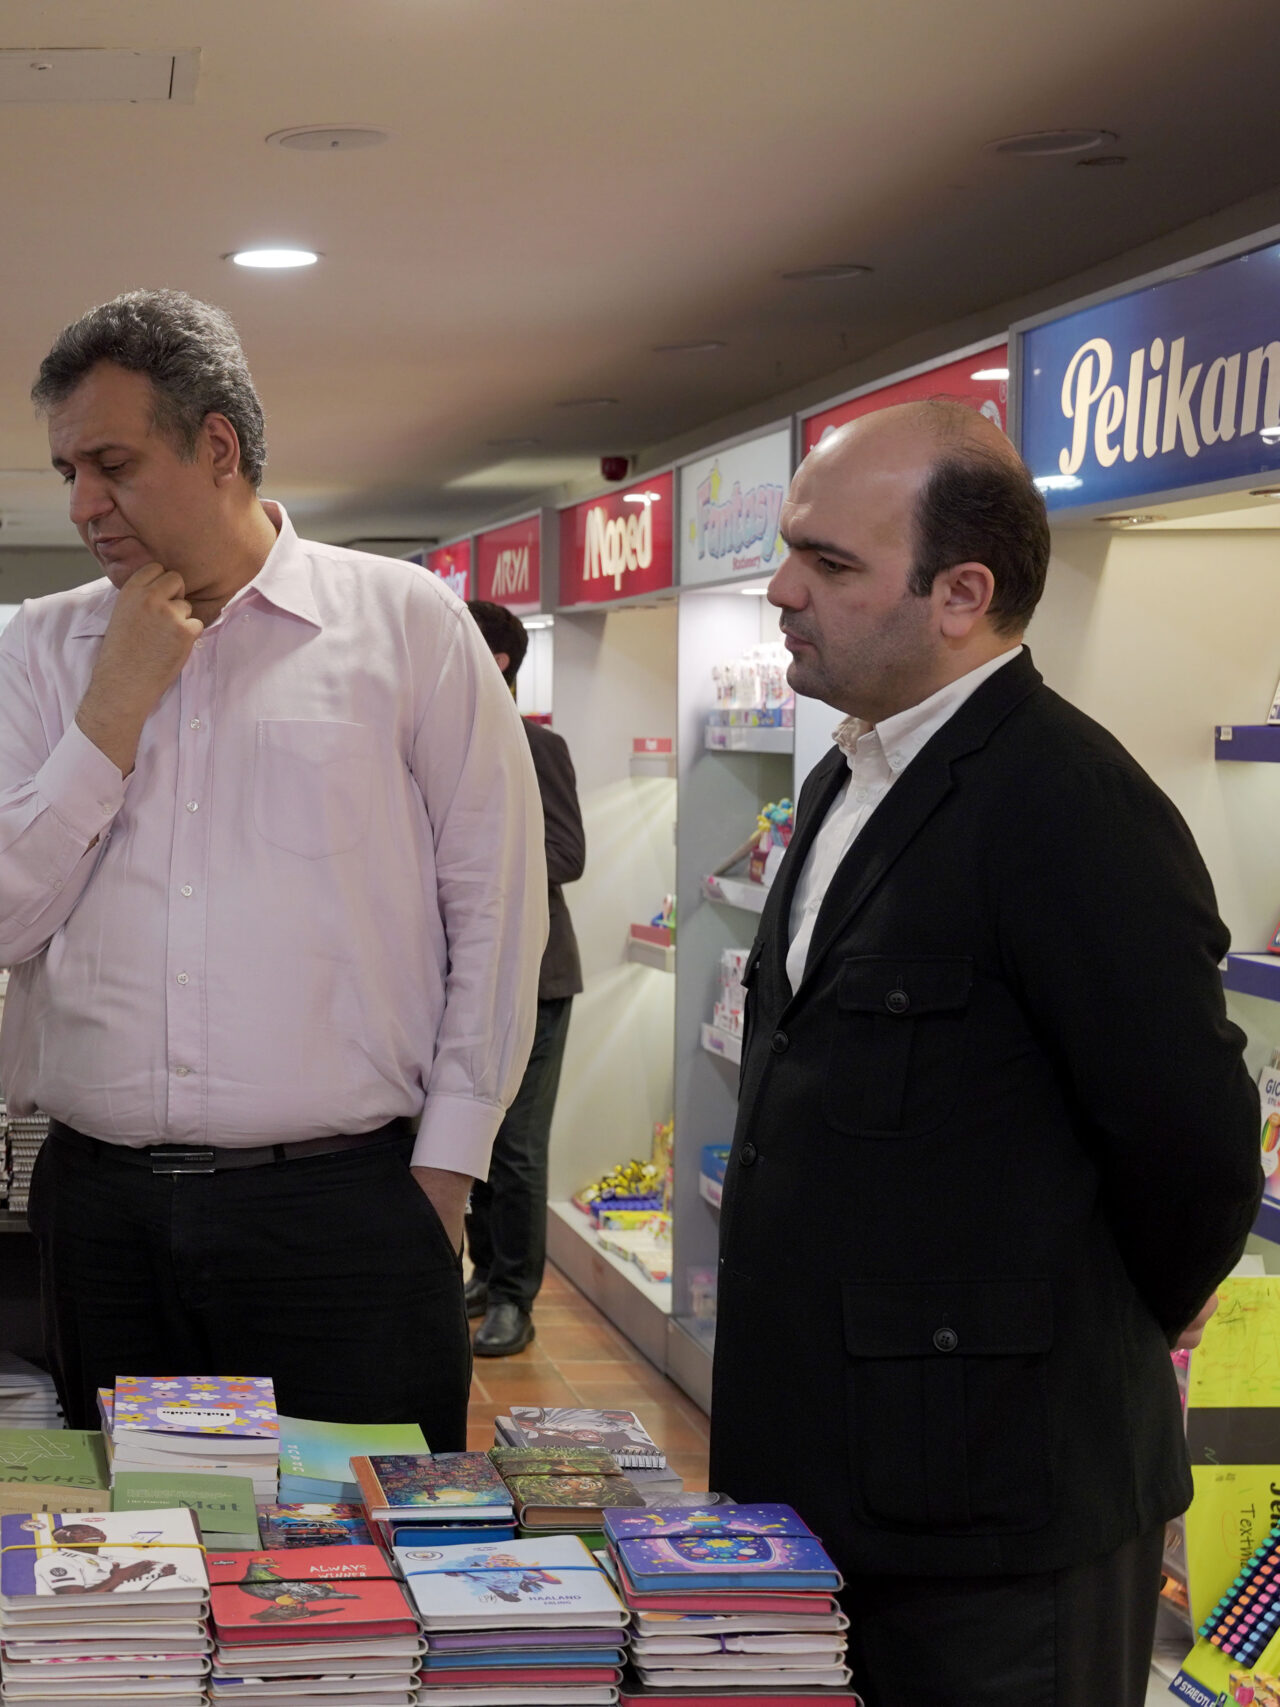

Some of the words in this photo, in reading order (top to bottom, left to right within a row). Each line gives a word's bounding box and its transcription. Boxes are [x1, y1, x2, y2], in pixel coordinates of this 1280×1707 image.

[1059, 336, 1280, 475] Pelikan
[583, 499, 652, 591] Maped
[697, 479, 784, 563] Fantasy
[491, 546, 529, 598] ARYA
[310, 1564, 367, 1573] ALWAYS
